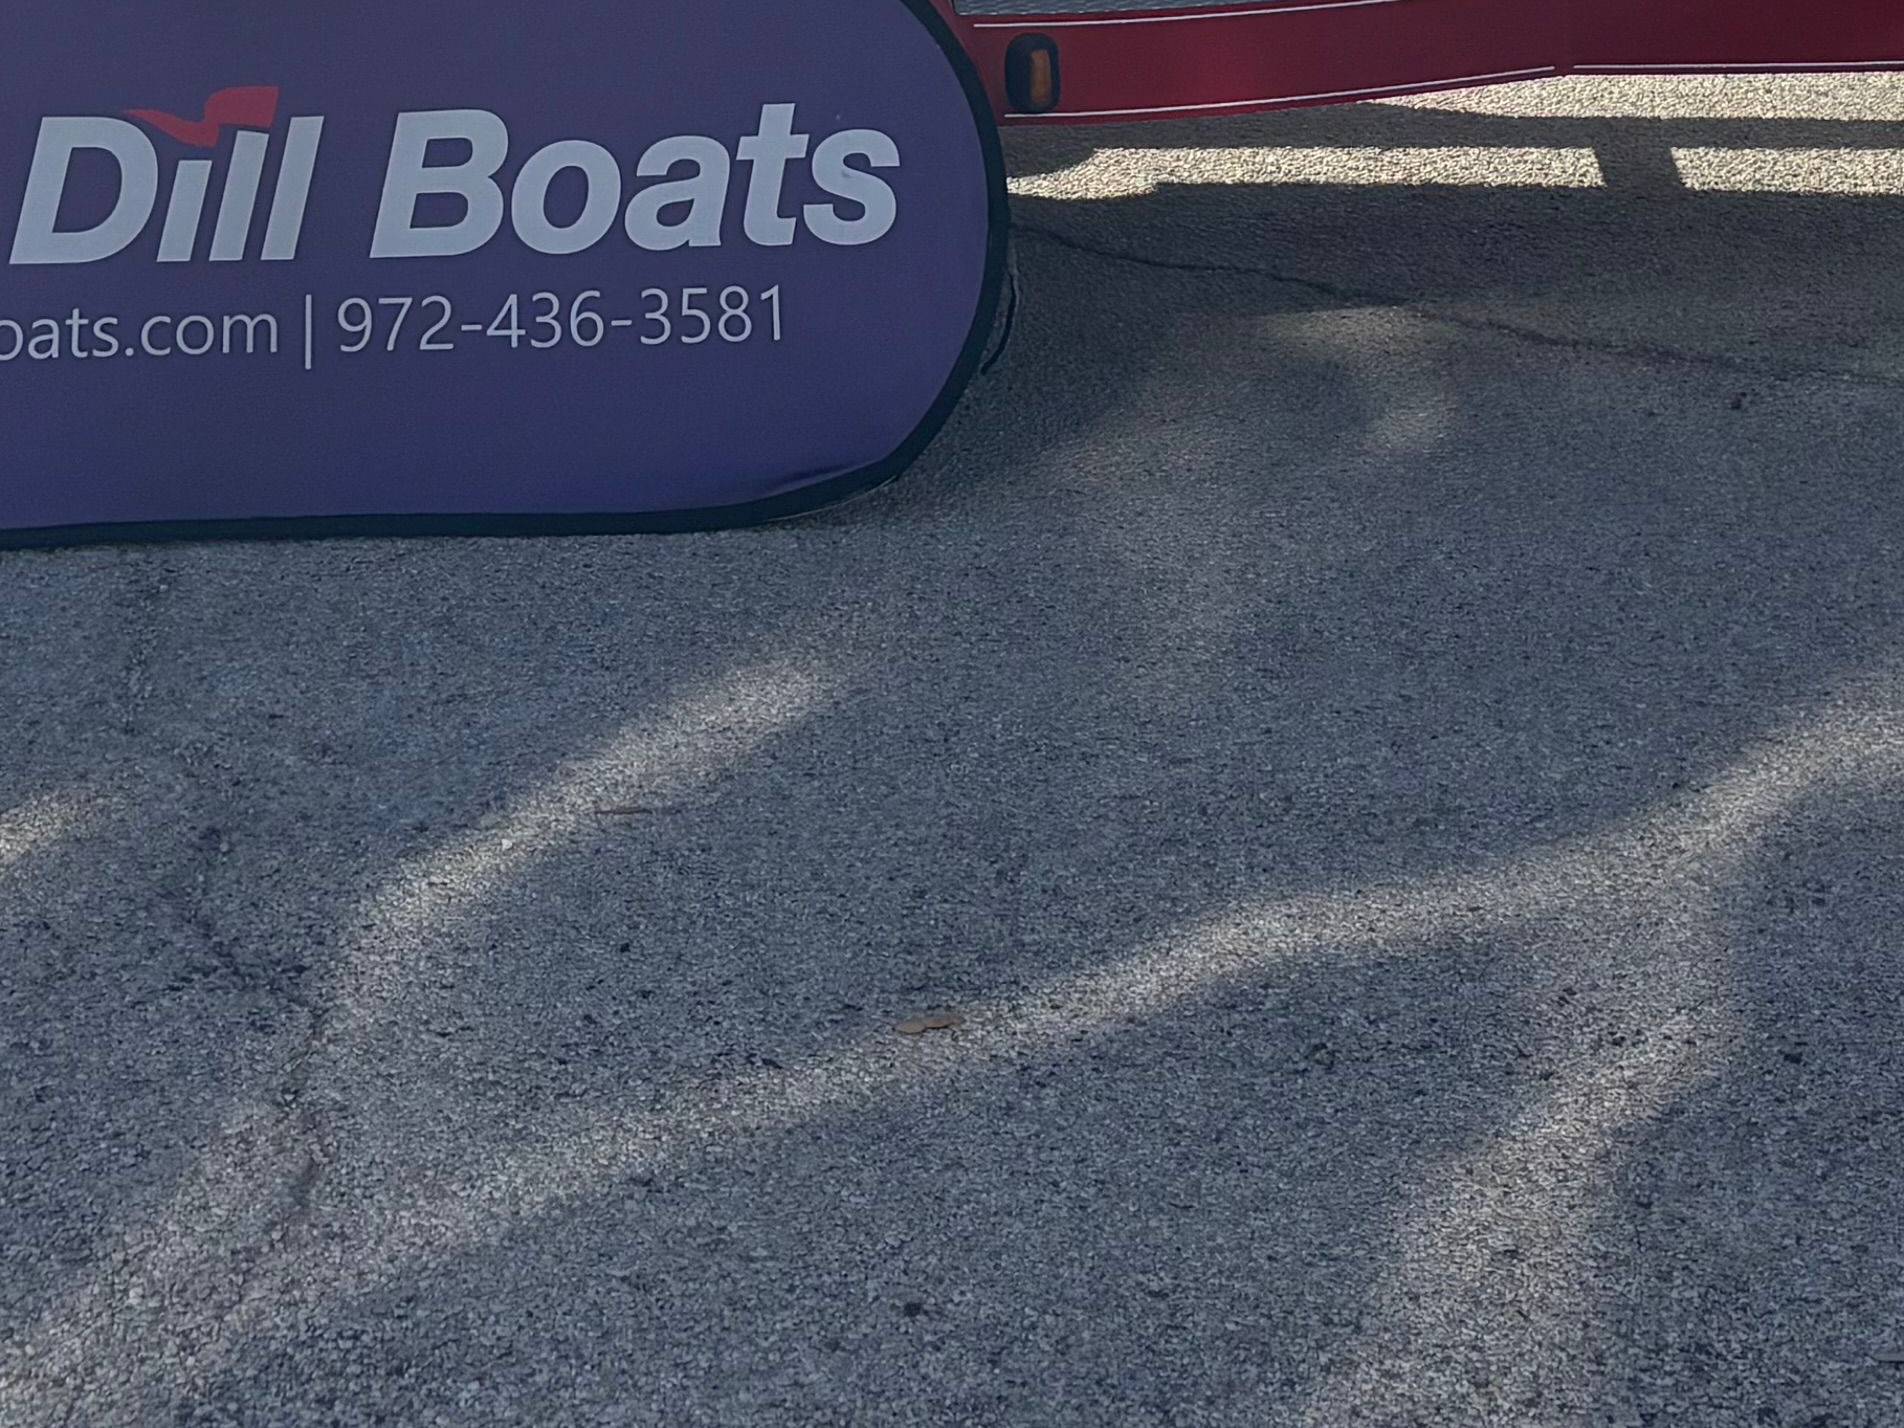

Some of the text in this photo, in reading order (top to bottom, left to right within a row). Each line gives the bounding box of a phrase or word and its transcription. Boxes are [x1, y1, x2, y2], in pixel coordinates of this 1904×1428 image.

[8, 115, 325, 265] Dill
[369, 102, 901, 259] Boats
[336, 284, 783, 353] 972-436-3581
